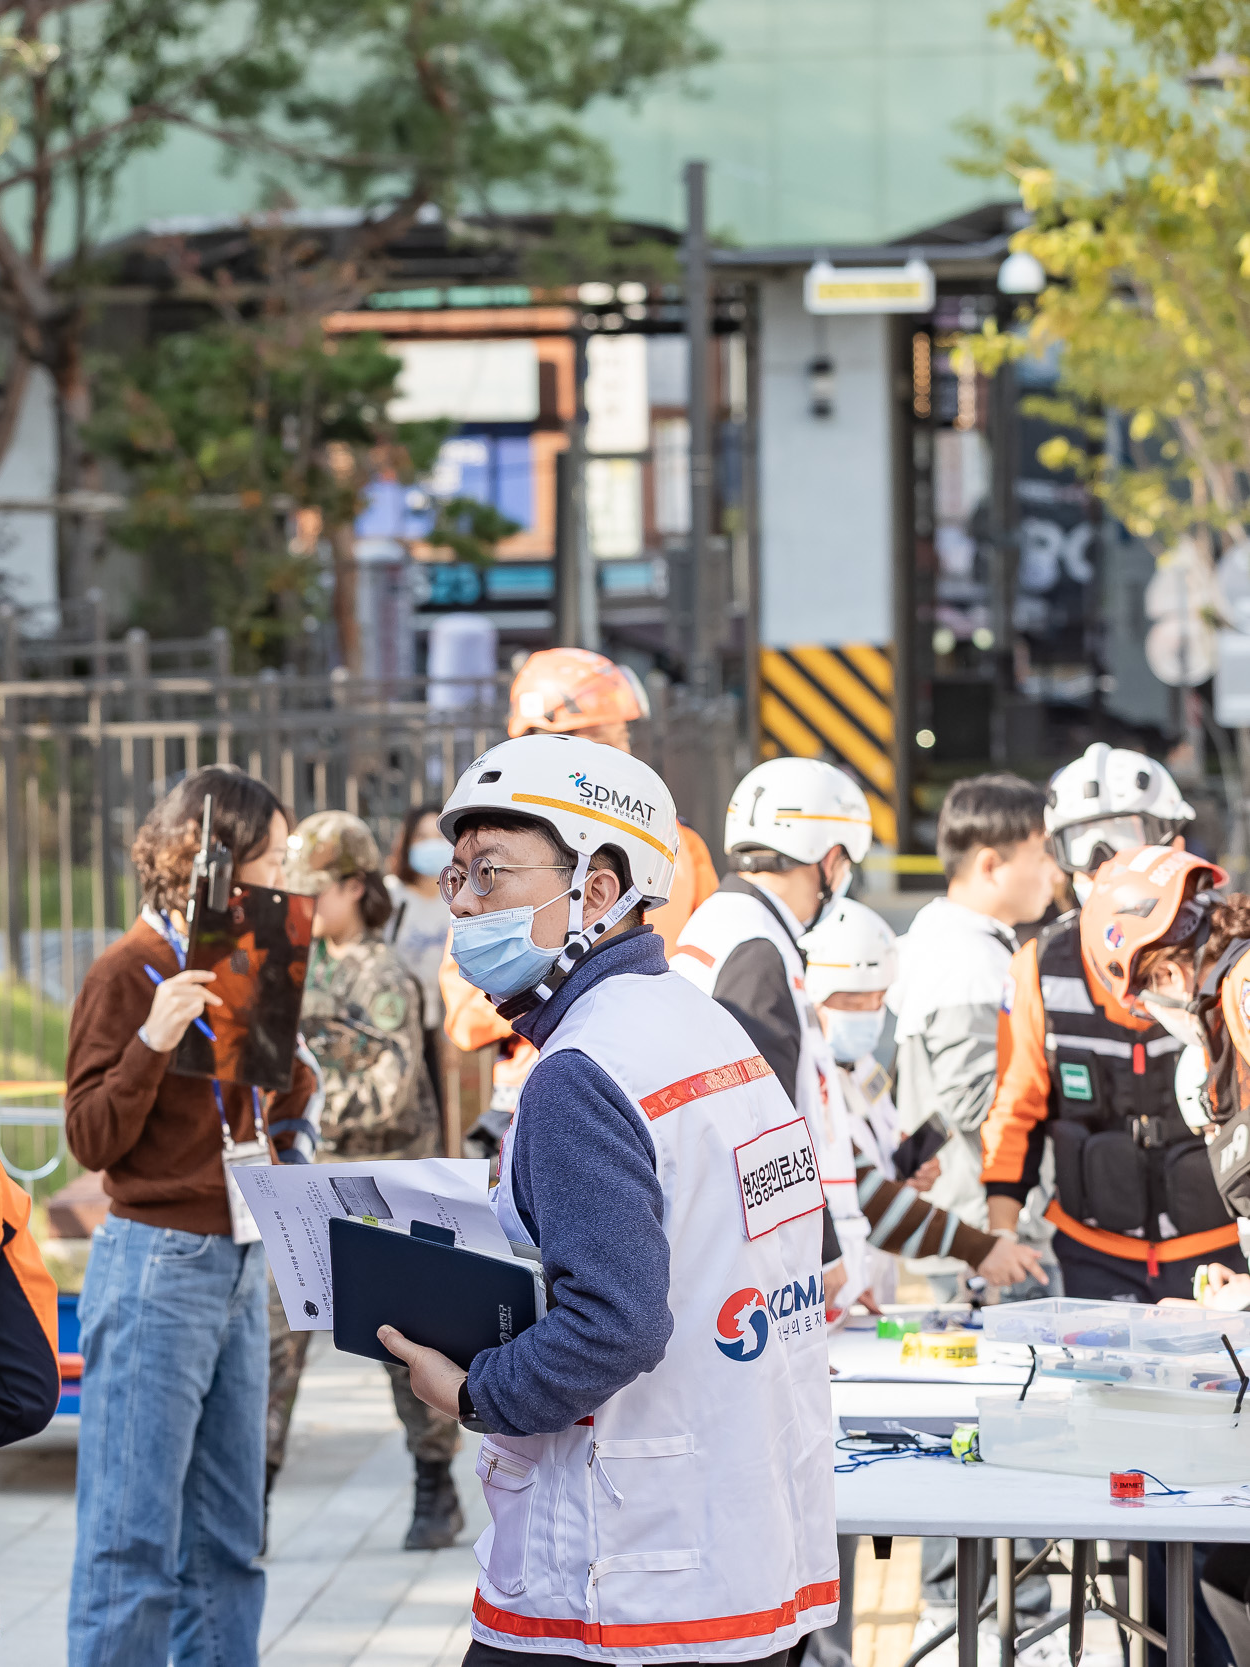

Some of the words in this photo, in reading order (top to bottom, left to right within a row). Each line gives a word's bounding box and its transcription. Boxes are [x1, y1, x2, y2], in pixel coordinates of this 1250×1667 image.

[579, 781, 656, 821] SDMAT
[579, 797, 610, 811] 서울특별시
[742, 1145, 816, 1210] 현장응급의료소장
